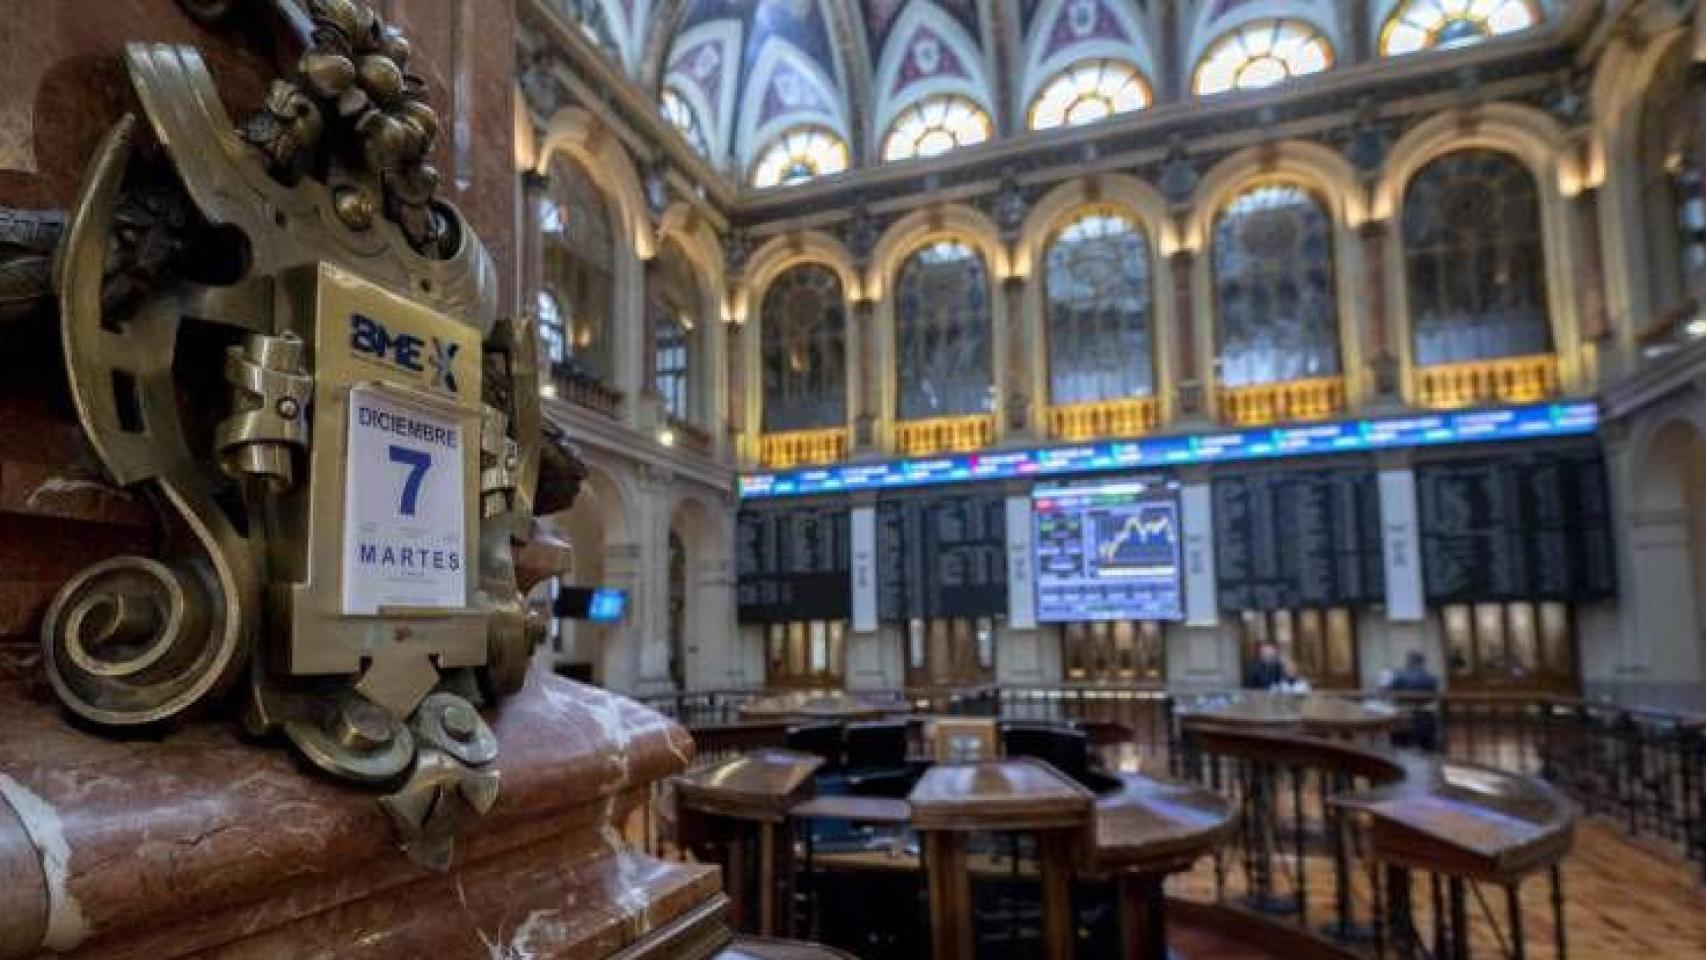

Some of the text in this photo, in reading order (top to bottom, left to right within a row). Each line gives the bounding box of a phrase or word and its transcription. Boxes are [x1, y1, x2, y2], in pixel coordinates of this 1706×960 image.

[358, 407, 457, 448] DICIEMBRE
[389, 445, 432, 516] 7
[360, 544, 460, 571] MARTES
